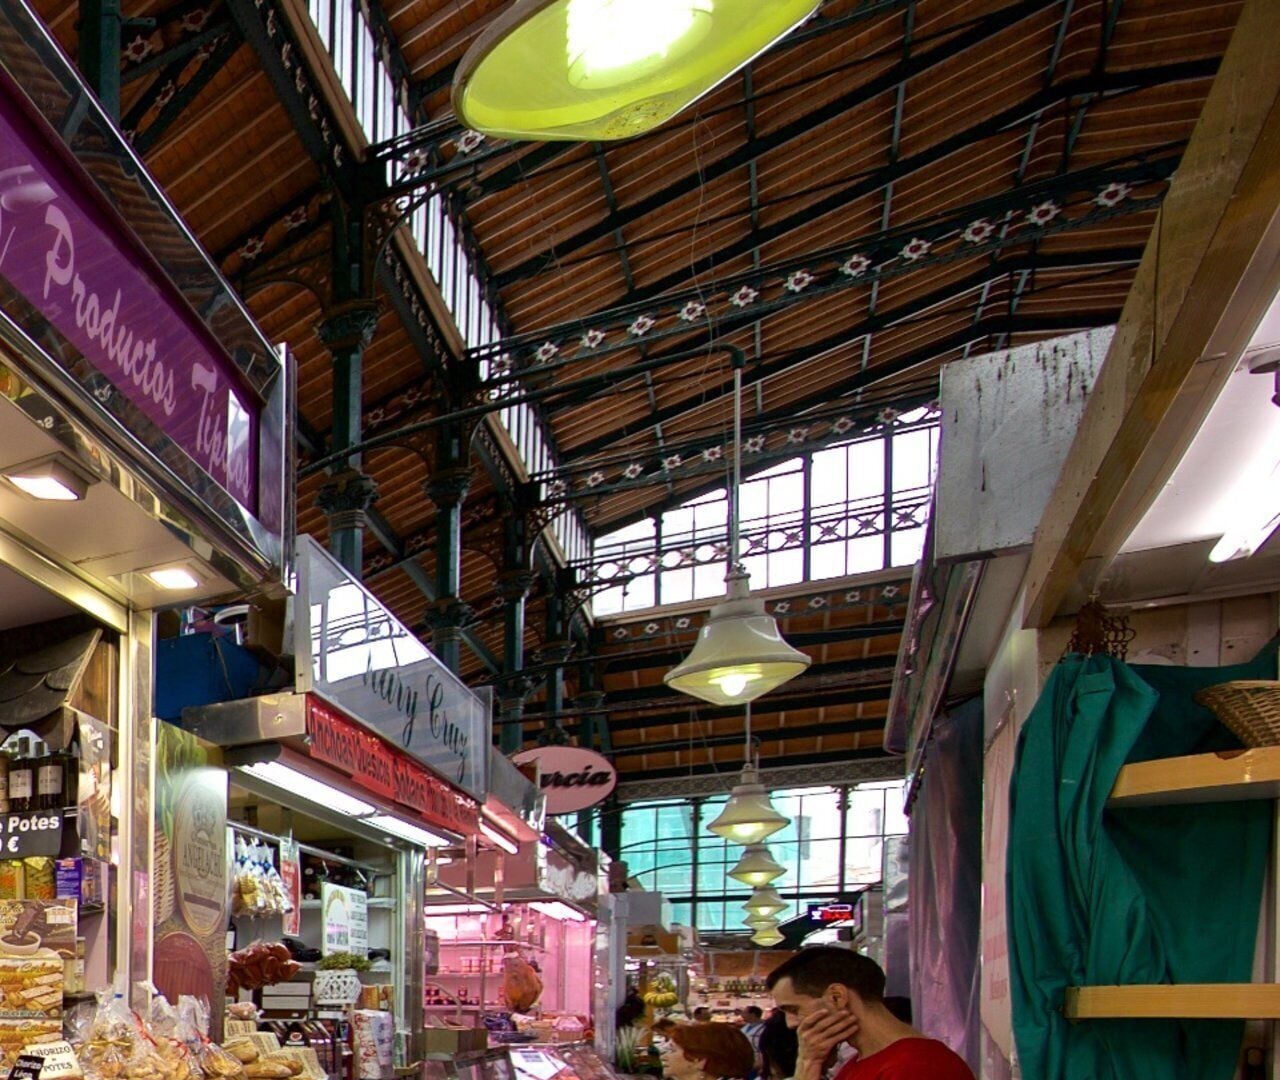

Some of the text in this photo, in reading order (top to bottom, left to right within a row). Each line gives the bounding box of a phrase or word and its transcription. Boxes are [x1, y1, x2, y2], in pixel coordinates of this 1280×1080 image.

[44, 204, 176, 416] Productos
[426, 673, 469, 784] Cruz
[7, 814, 60, 833] Potes
[7, 835, 20, 852] €
[43, 1061, 73, 1073] POTES
